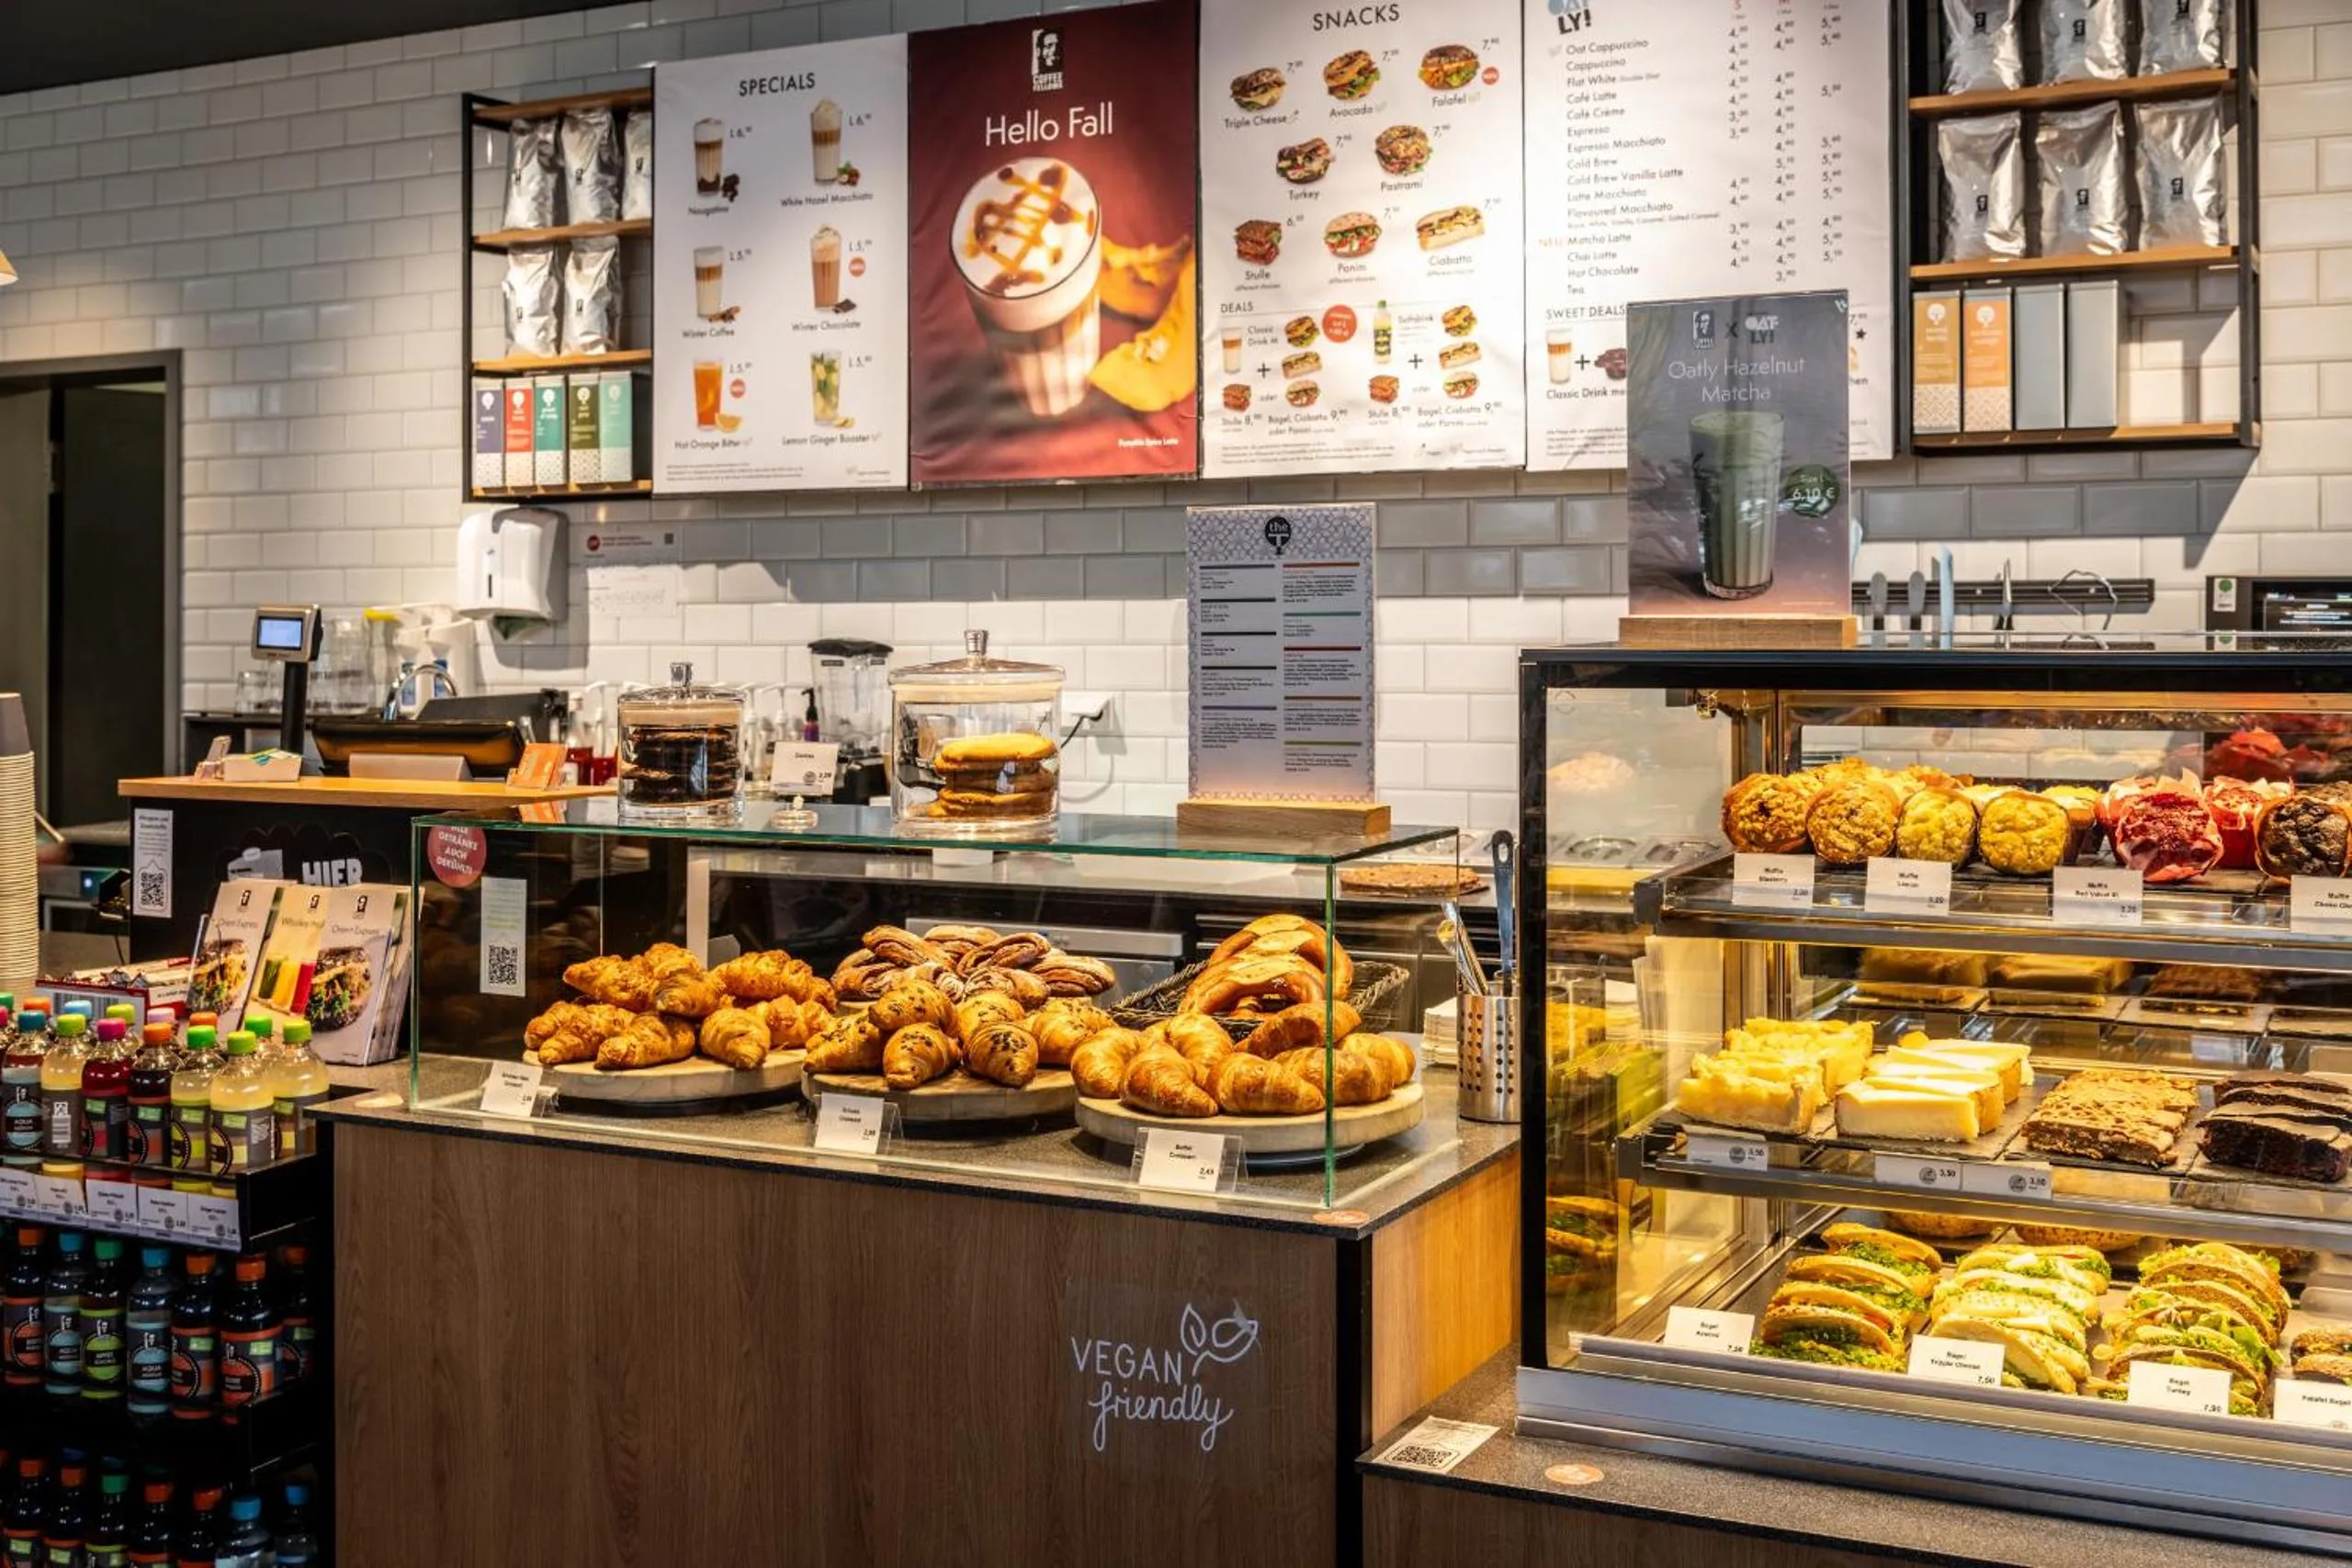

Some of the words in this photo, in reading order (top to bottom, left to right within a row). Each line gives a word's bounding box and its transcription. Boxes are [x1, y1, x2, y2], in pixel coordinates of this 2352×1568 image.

[1313, 4, 1400, 31] SNACKS
[1557, 8, 1592, 35] LY!
[1566, 44, 1586, 55] Oat
[1589, 39, 1649, 53] Cappuccino
[1566, 57, 1626, 72] Cappuccino
[739, 72, 816, 97] SPECIALS
[1033, 72, 1064, 85] COFFEE
[1588, 73, 1617, 85] White
[1431, 94, 1467, 108] Falafel
[1593, 91, 1617, 102] Latte
[1329, 104, 1374, 118] Avocado
[985, 109, 1060, 148] Hello
[1069, 100, 1114, 139] Fall
[1224, 117, 1251, 130] Triple
[1253, 114, 1287, 128] Cheese
[1567, 126, 1611, 139] Espresso
[1567, 141, 1610, 154] Espresso
[1612, 136, 1667, 150] Macchiato
[1567, 158, 1591, 170] Cold
[1593, 157, 1618, 168] Brew
[1567, 175, 1591, 186] Cold
[1593, 174, 1618, 184] Brew
[1621, 169, 1657, 182] Vanilla
[1658, 167, 1684, 178] Latte
[1381, 181, 1423, 193] Pastrami
[780, 196, 804, 208] White
[1289, 188, 1320, 202] Turkey
[1567, 192, 1591, 203] Latte
[1593, 187, 1648, 200] Macchiato
[1567, 207, 1617, 219] Flavoured
[1619, 201, 1674, 215] Macchiato
[1567, 234, 1606, 246] Matcha
[1608, 232, 1632, 243] Latte
[1429, 254, 1473, 267] Ciabatta
[1593, 250, 1618, 261] Latte
[1588, 264, 1640, 276] Chocolate
[1567, 284, 1585, 295] Tea
[1220, 301, 1254, 314] DEALS
[1545, 307, 1585, 320] SWEET
[1589, 304, 1625, 318] DEALS
[1668, 358, 1718, 382] Oatly
[1724, 354, 1805, 376] Hazelnut
[1545, 389, 1579, 400] Classic
[1581, 387, 1608, 399] Drink
[1702, 382, 1771, 402] Matcha
[1792, 487, 1821, 502] 6,10
[301, 857, 364, 887] HIER
[1070, 1336, 1182, 1386] VEGAN
[1088, 1381, 1234, 1451] friendly
